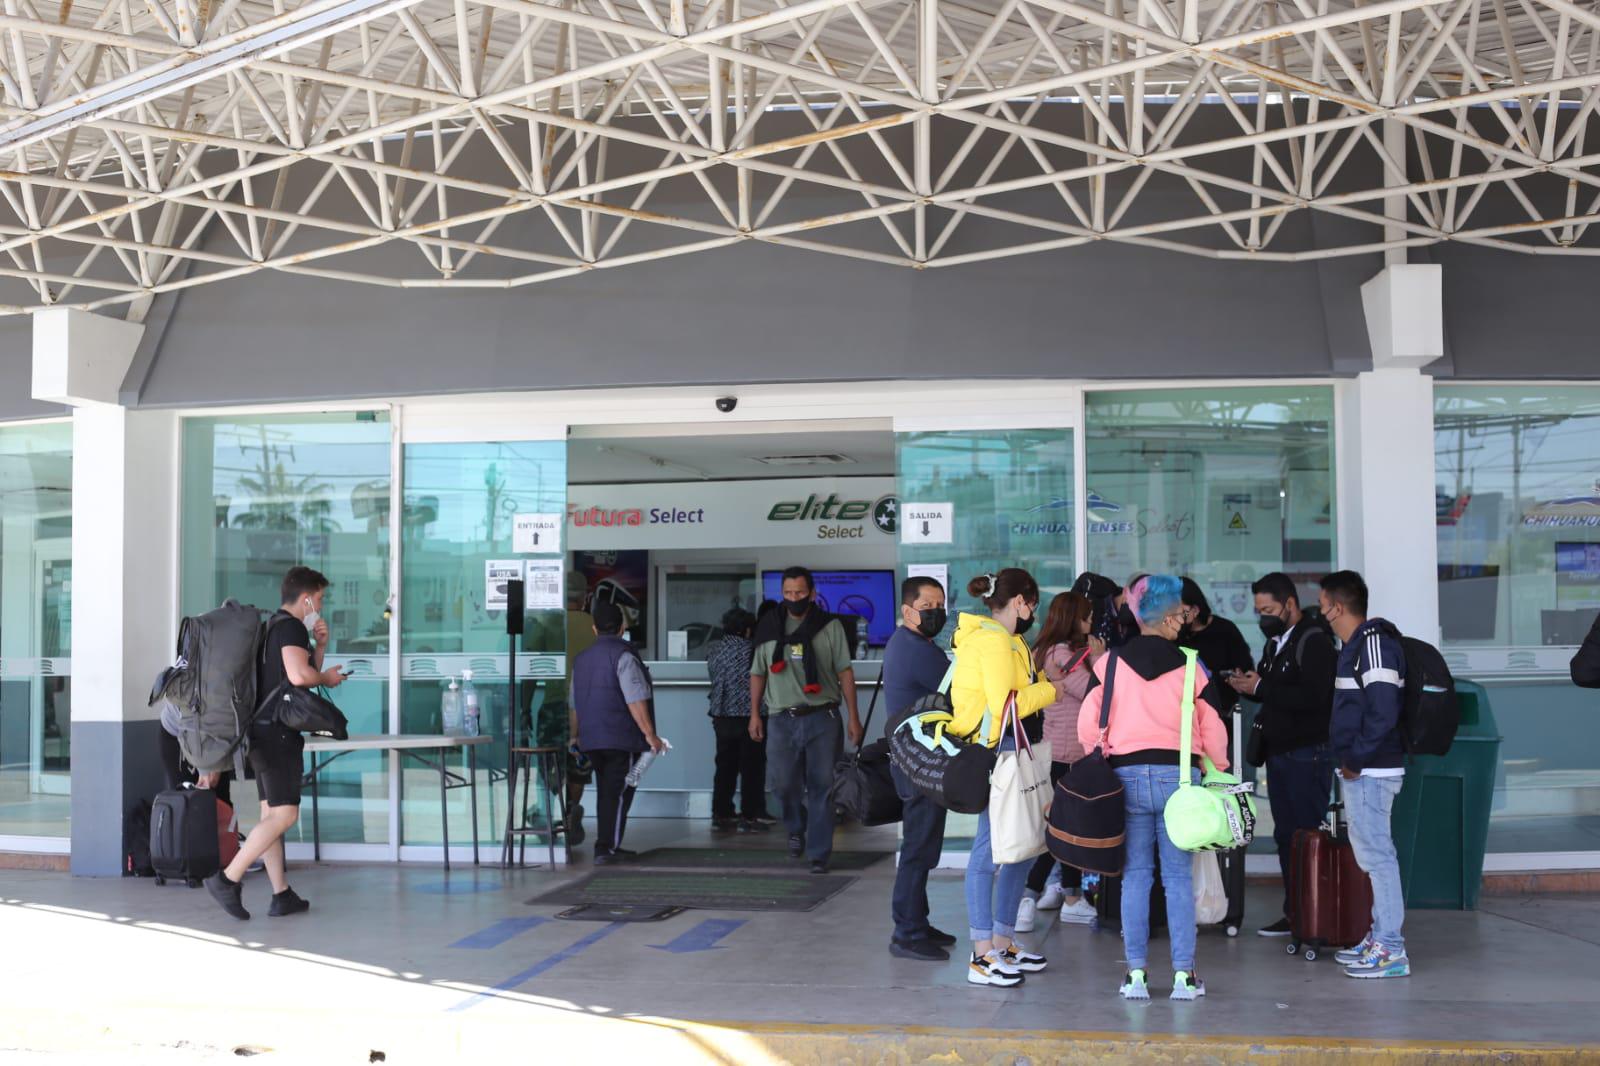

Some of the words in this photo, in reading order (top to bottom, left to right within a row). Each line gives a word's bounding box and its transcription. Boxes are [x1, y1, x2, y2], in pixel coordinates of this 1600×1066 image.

[767, 493, 873, 521] elite
[650, 507, 704, 524] Select
[909, 511, 943, 520] SALIDA
[1524, 515, 1600, 527] CHIHUAHU
[817, 525, 864, 539] Select
[1011, 522, 1136, 535] CHIHUAENSES
